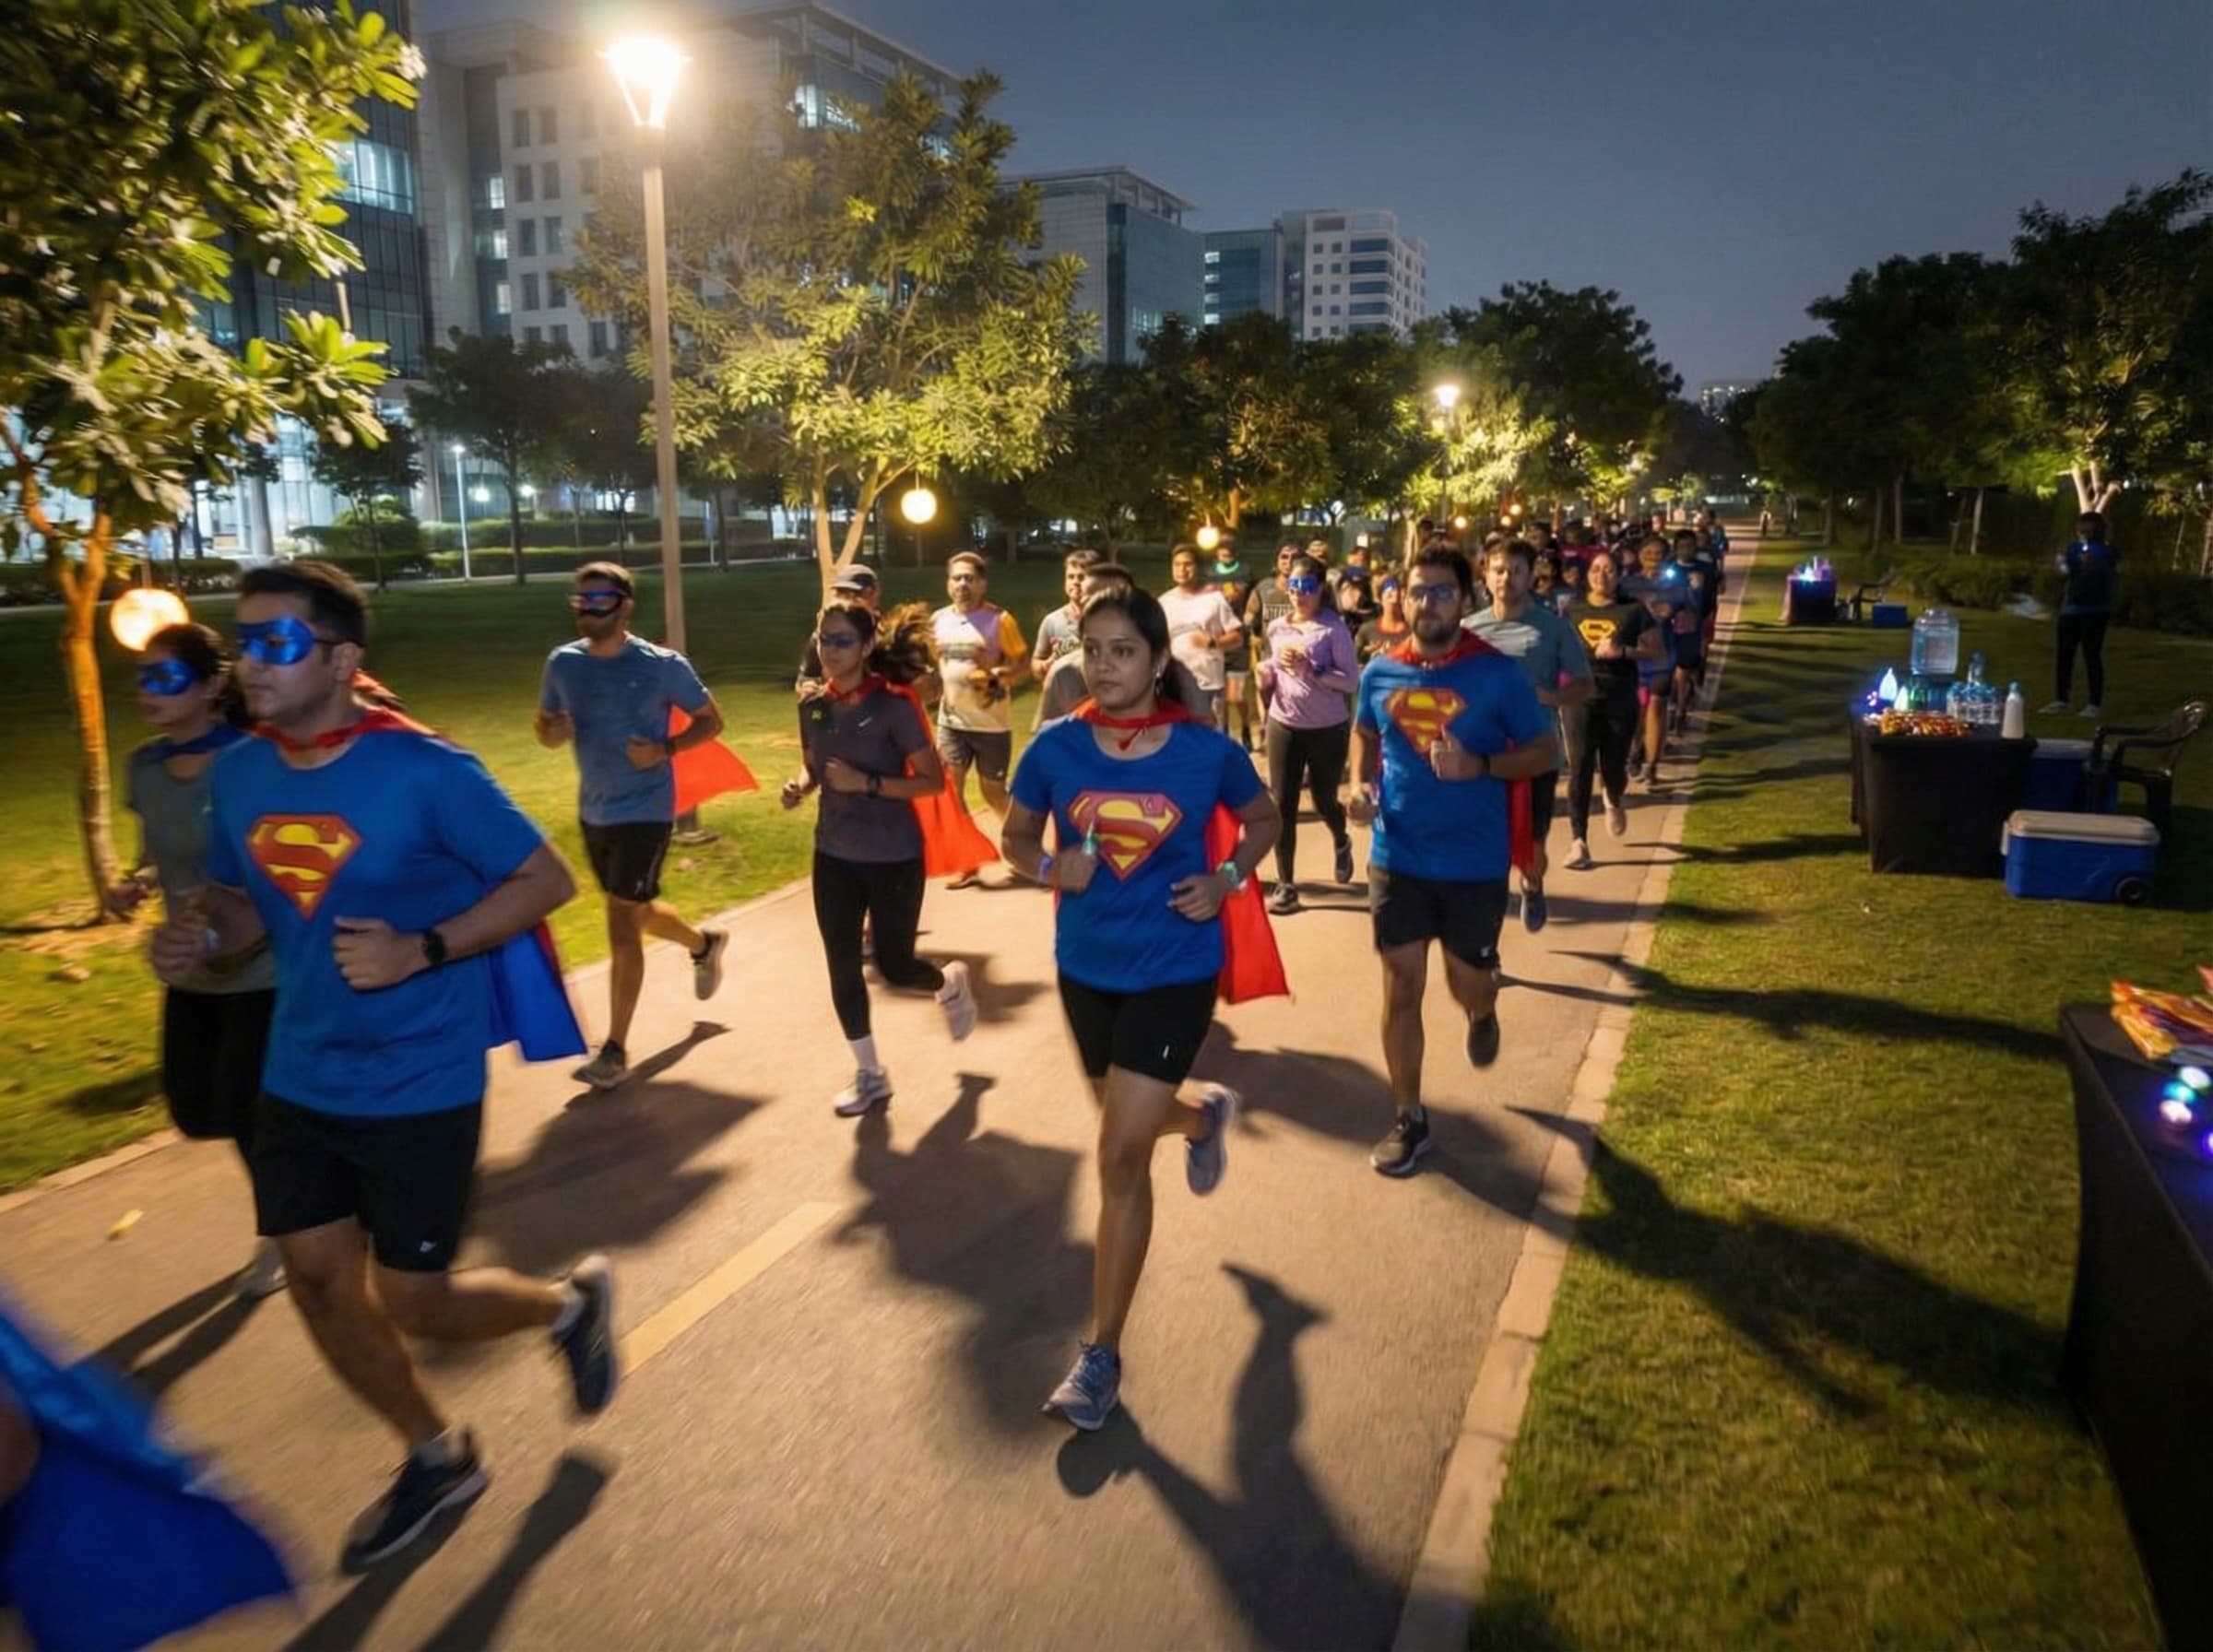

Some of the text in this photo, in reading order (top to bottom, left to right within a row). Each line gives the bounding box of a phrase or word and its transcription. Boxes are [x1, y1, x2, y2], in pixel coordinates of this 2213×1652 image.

[1387, 690, 1462, 741] S
[249, 815, 359, 902] S
[1071, 793, 1178, 865] S
